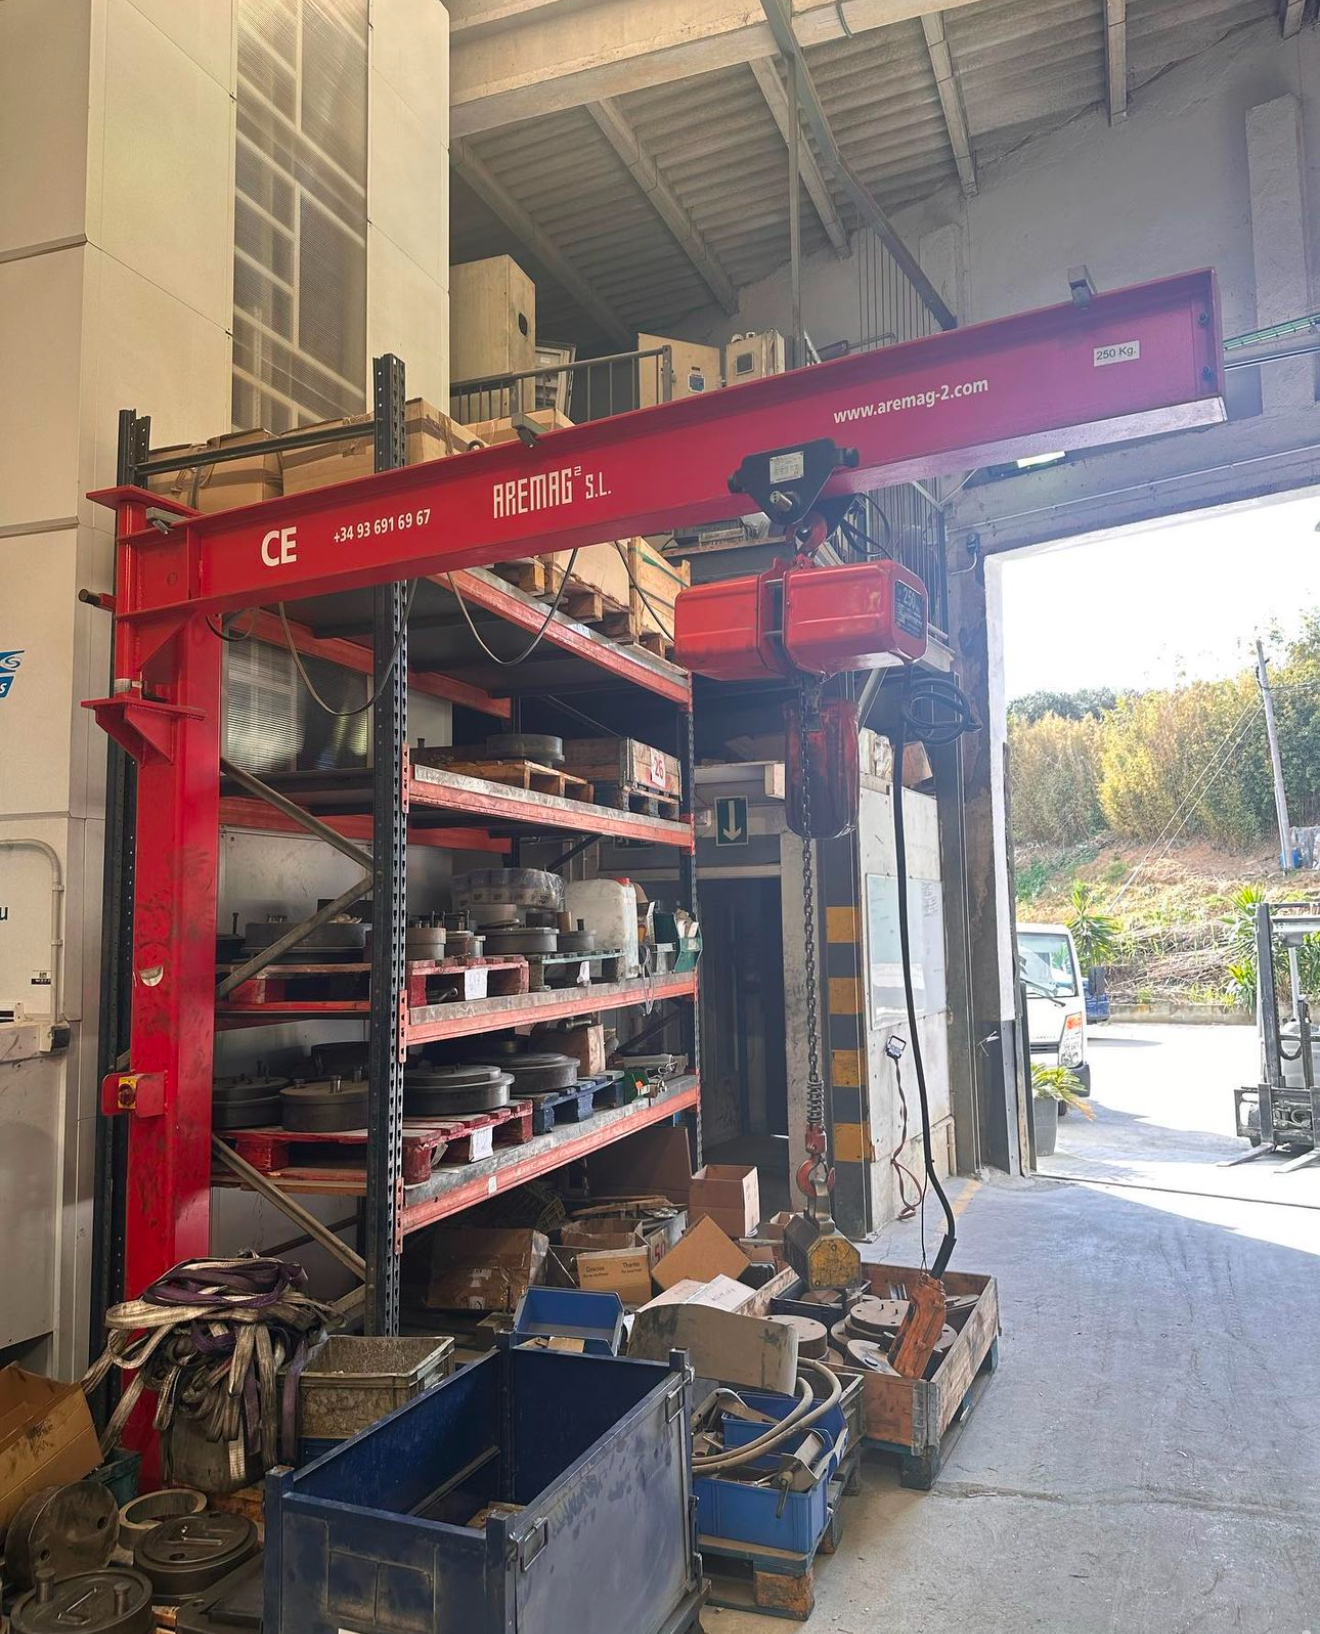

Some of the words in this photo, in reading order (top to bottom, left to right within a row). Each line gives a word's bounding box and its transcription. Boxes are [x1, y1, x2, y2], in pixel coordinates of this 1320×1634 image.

[1096, 348, 1116, 360] 250
[1119, 345, 1136, 357] Kg.
[833, 379, 989, 424] www.aremag-2.com
[585, 471, 612, 500] S.L.
[333, 526, 354, 543] +34
[357, 521, 371, 539] 93
[374, 516, 394, 535] 691
[397, 512, 413, 530] 69
[416, 508, 431, 526] 67
[261, 526, 298, 567] CE
